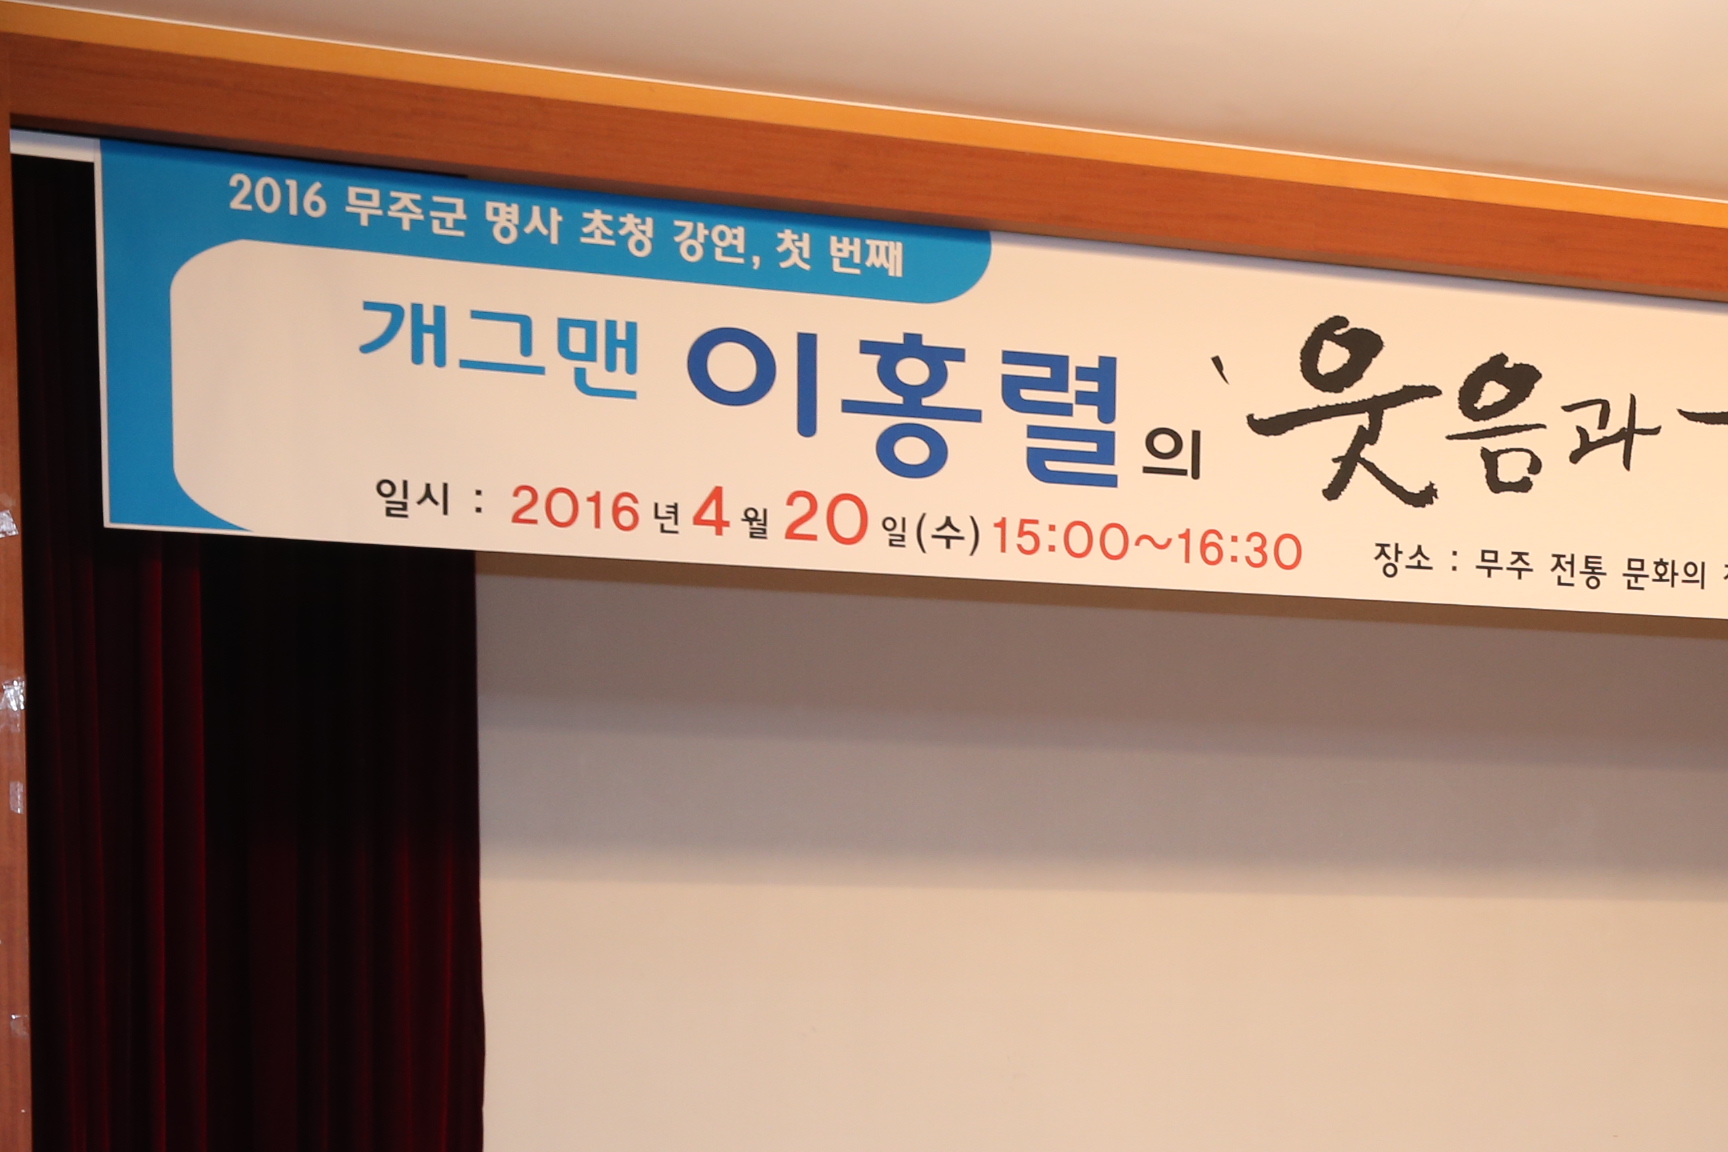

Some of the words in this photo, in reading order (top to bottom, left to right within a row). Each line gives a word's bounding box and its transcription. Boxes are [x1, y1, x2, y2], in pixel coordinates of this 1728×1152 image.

[229, 174, 326, 217] 2016
[345, 186, 467, 237] 무주군
[485, 201, 563, 245] 명사
[580, 209, 653, 257] 초청
[673, 220, 760, 270] 강연,
[776, 229, 812, 271] 첫
[830, 235, 903, 277] 번째
[359, 301, 637, 400] 개그맨
[687, 327, 1200, 488] 이홍렬의
[376, 479, 448, 518] 일시
[512, 485, 679, 533] 2016년
[693, 486, 767, 540] 4월
[994, 518, 1302, 570] 15:00~16:30
[1374, 543, 1433, 578] 장소
[1475, 549, 1533, 580] 무주
[1551, 554, 1606, 590] 전통
[1623, 556, 1706, 590] 문화의
